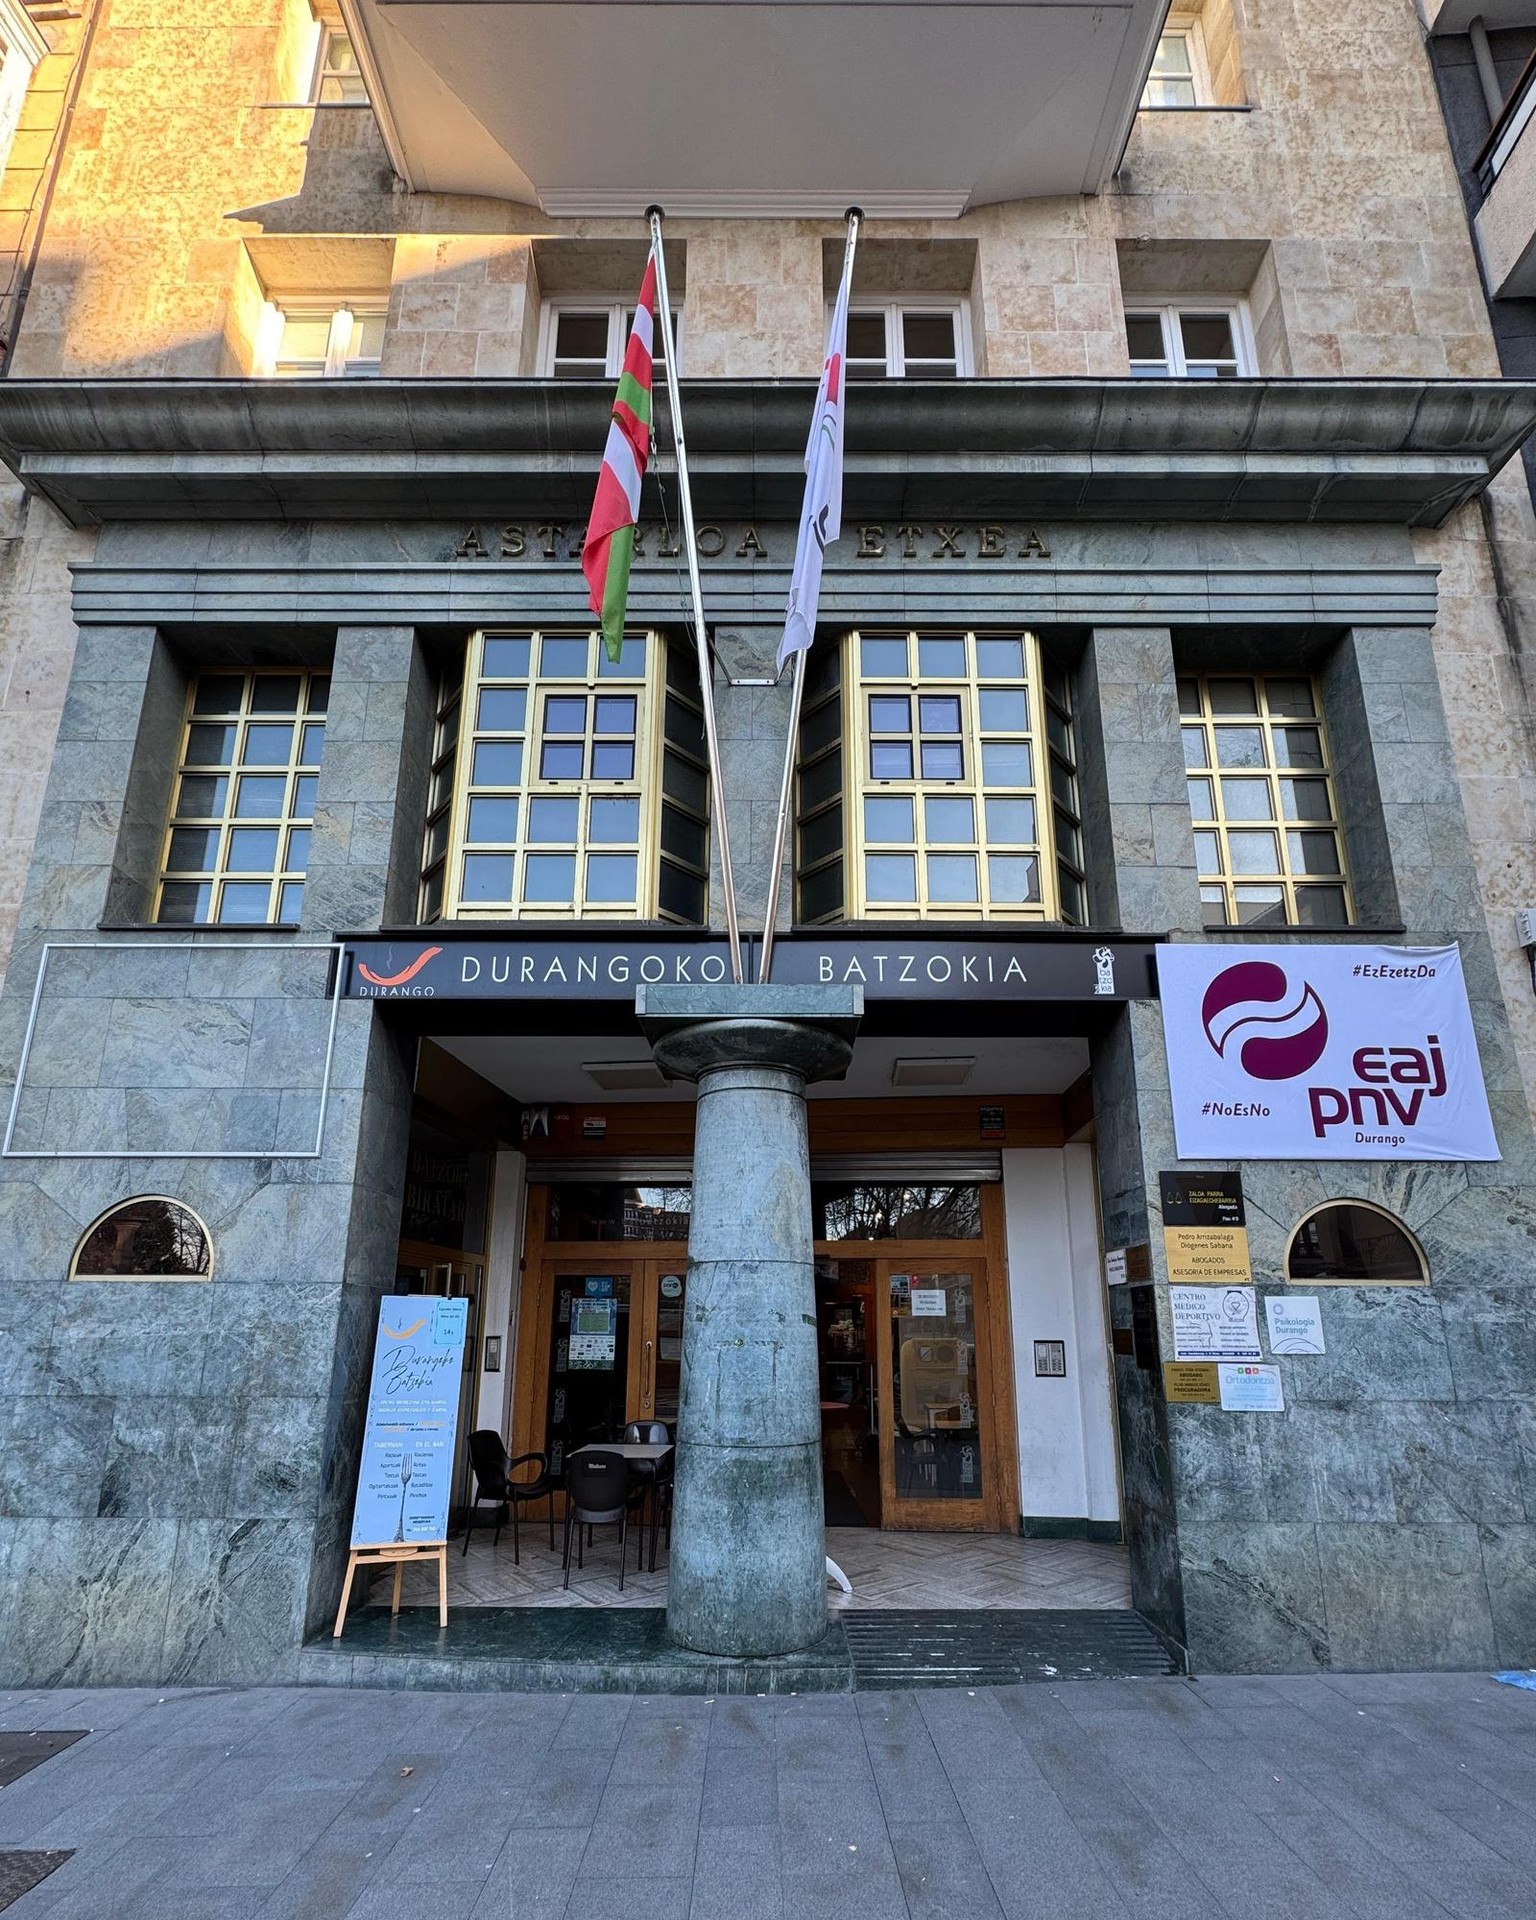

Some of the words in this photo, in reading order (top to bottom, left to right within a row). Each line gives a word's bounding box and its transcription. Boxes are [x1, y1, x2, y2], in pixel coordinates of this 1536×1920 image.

[857, 525, 1051, 557] ETXEA
[461, 955, 725, 983] DURANGOKO
[819, 955, 1027, 983] BATZOKIA
[1352, 964, 1437, 980] #EzEzetzDa
[359, 986, 435, 997] DURANGO
[1352, 1035, 1448, 1097] eaj
[1201, 1102, 1271, 1118] #NoEsNo
[1307, 1087, 1425, 1138] pnv
[1354, 1132, 1406, 1147] Durango
[1172, 1293, 1206, 1301] CENTRO
[1275, 1327, 1308, 1335] Durango
[1226, 1375, 1275, 1384] Ortodontzia
